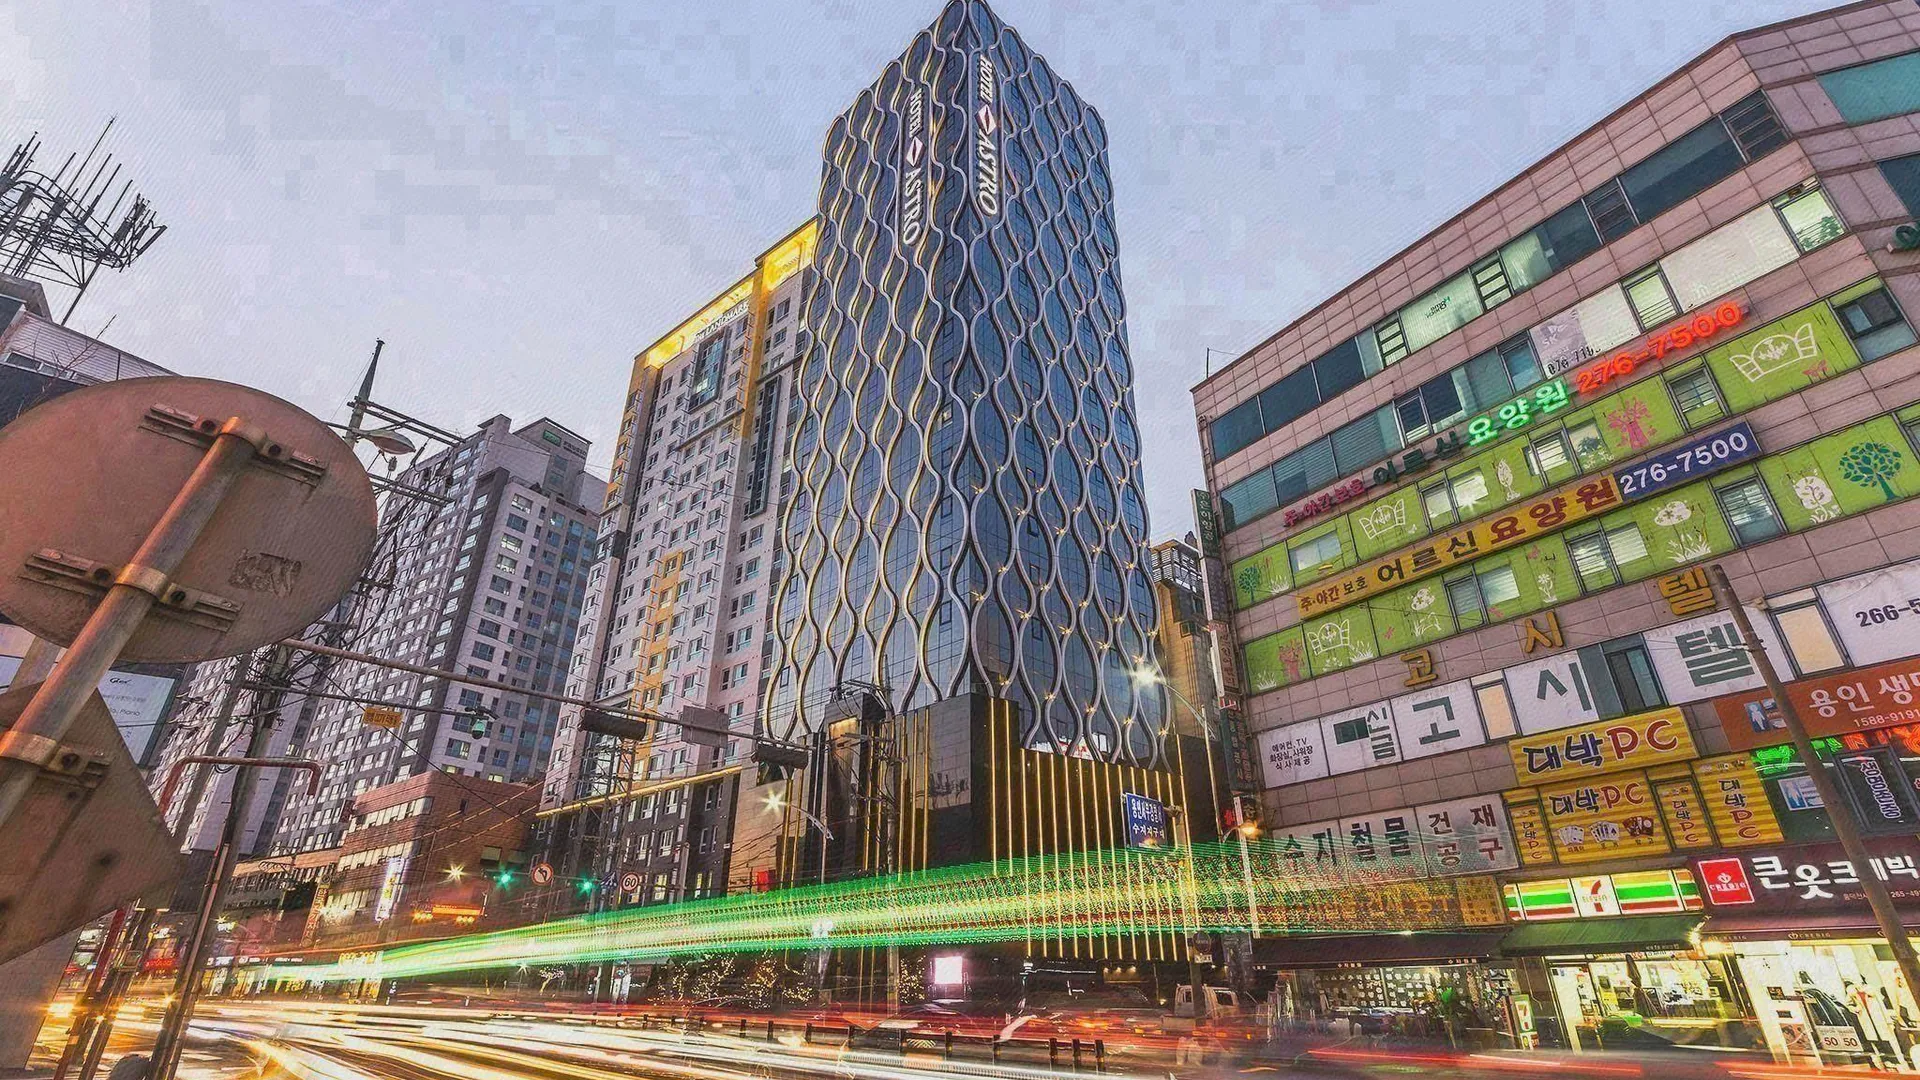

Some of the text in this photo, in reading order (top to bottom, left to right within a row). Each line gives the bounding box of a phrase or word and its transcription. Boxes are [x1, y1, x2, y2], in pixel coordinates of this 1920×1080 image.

[978, 53, 998, 216] HOTEL ASTRO
[903, 87, 925, 245] HOTEL ASTRO
[1467, 380, 1572, 446] 요양원
[1576, 300, 1744, 393] 276-7500
[1343, 575, 1369, 595] 보호
[1377, 531, 1480, 584] 어르신
[1490, 477, 1619, 546] 요양원
[1619, 432, 1749, 496] 276-7500
[1809, 681, 1875, 718] 용인
[1854, 707, 1920, 728] 1588-9191
[1428, 803, 1499, 836] 건재
[625, 877, 637, 888] 60
[1823, 1036, 1858, 1047] 50 50
